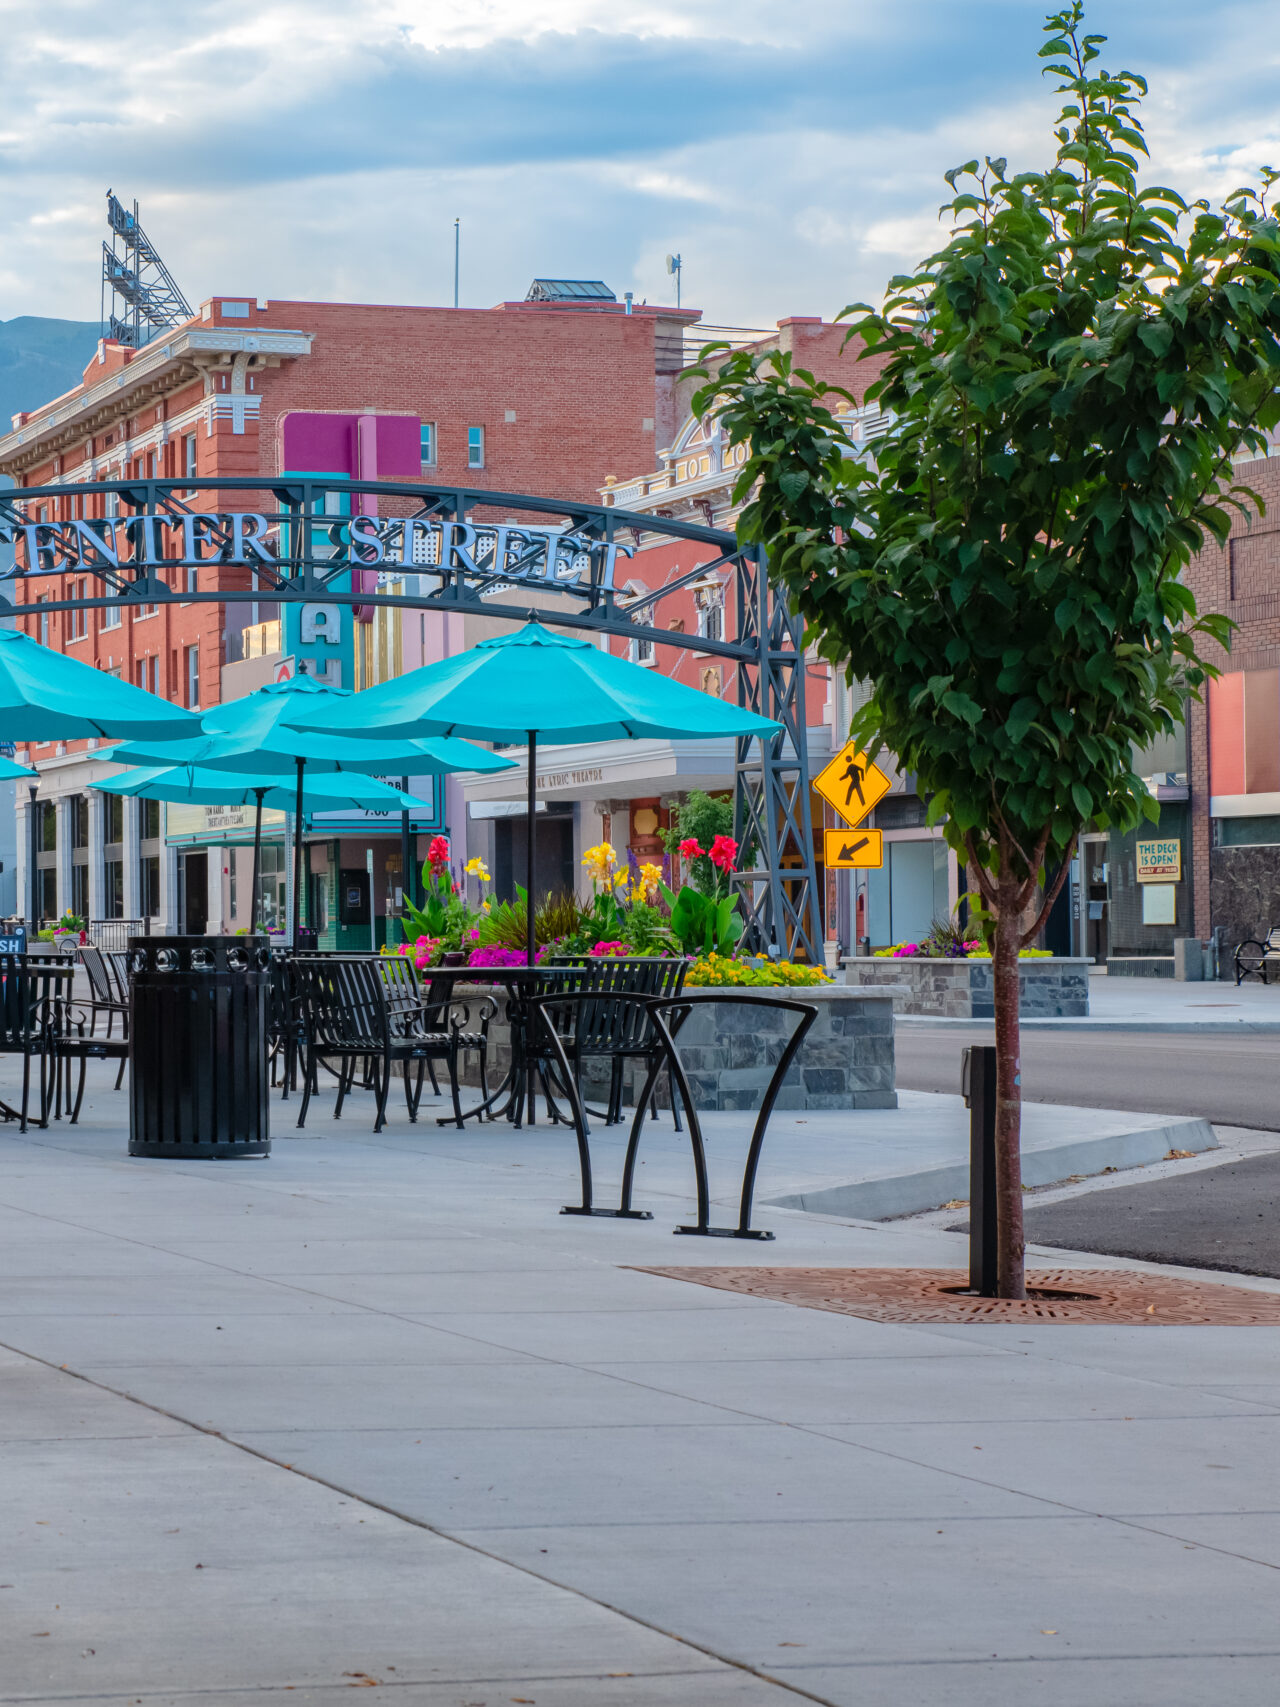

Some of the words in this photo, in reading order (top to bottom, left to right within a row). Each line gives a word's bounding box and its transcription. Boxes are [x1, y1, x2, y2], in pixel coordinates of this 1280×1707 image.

[349, 515, 635, 594] STREET
[1139, 844, 1155, 854] THE
[1157, 843, 1177, 854] DECK
[1141, 855, 1148, 865] IS
[1150, 854, 1176, 865] OPEN!
